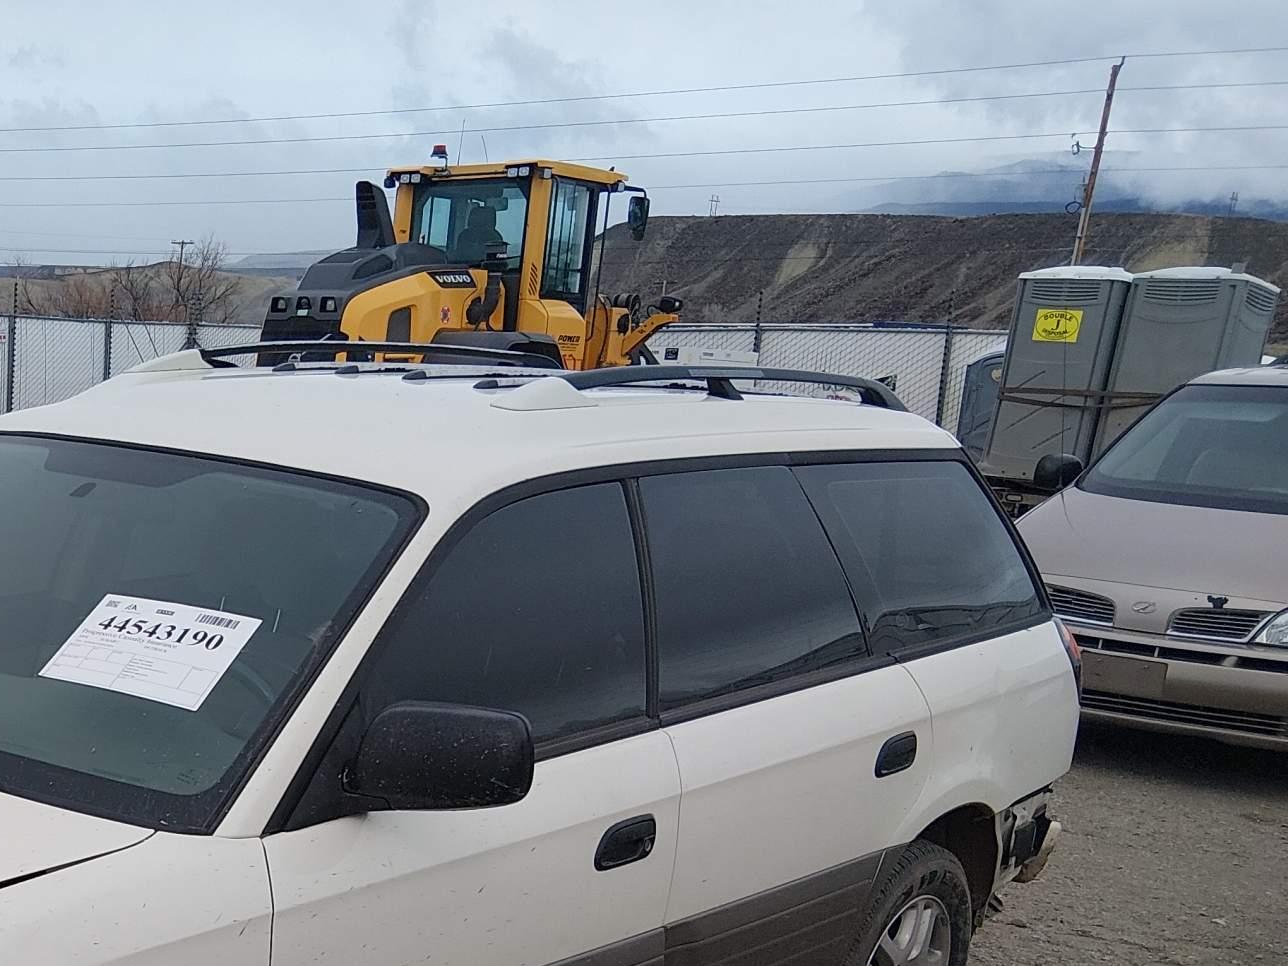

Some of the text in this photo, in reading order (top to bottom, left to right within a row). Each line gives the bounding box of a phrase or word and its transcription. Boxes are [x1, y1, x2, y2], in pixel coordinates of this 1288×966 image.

[435, 274, 471, 283] VOLVO
[1043, 313, 1073, 322] DOUBLE
[1050, 319, 1061, 331] J
[98, 615, 224, 650] 44543190
